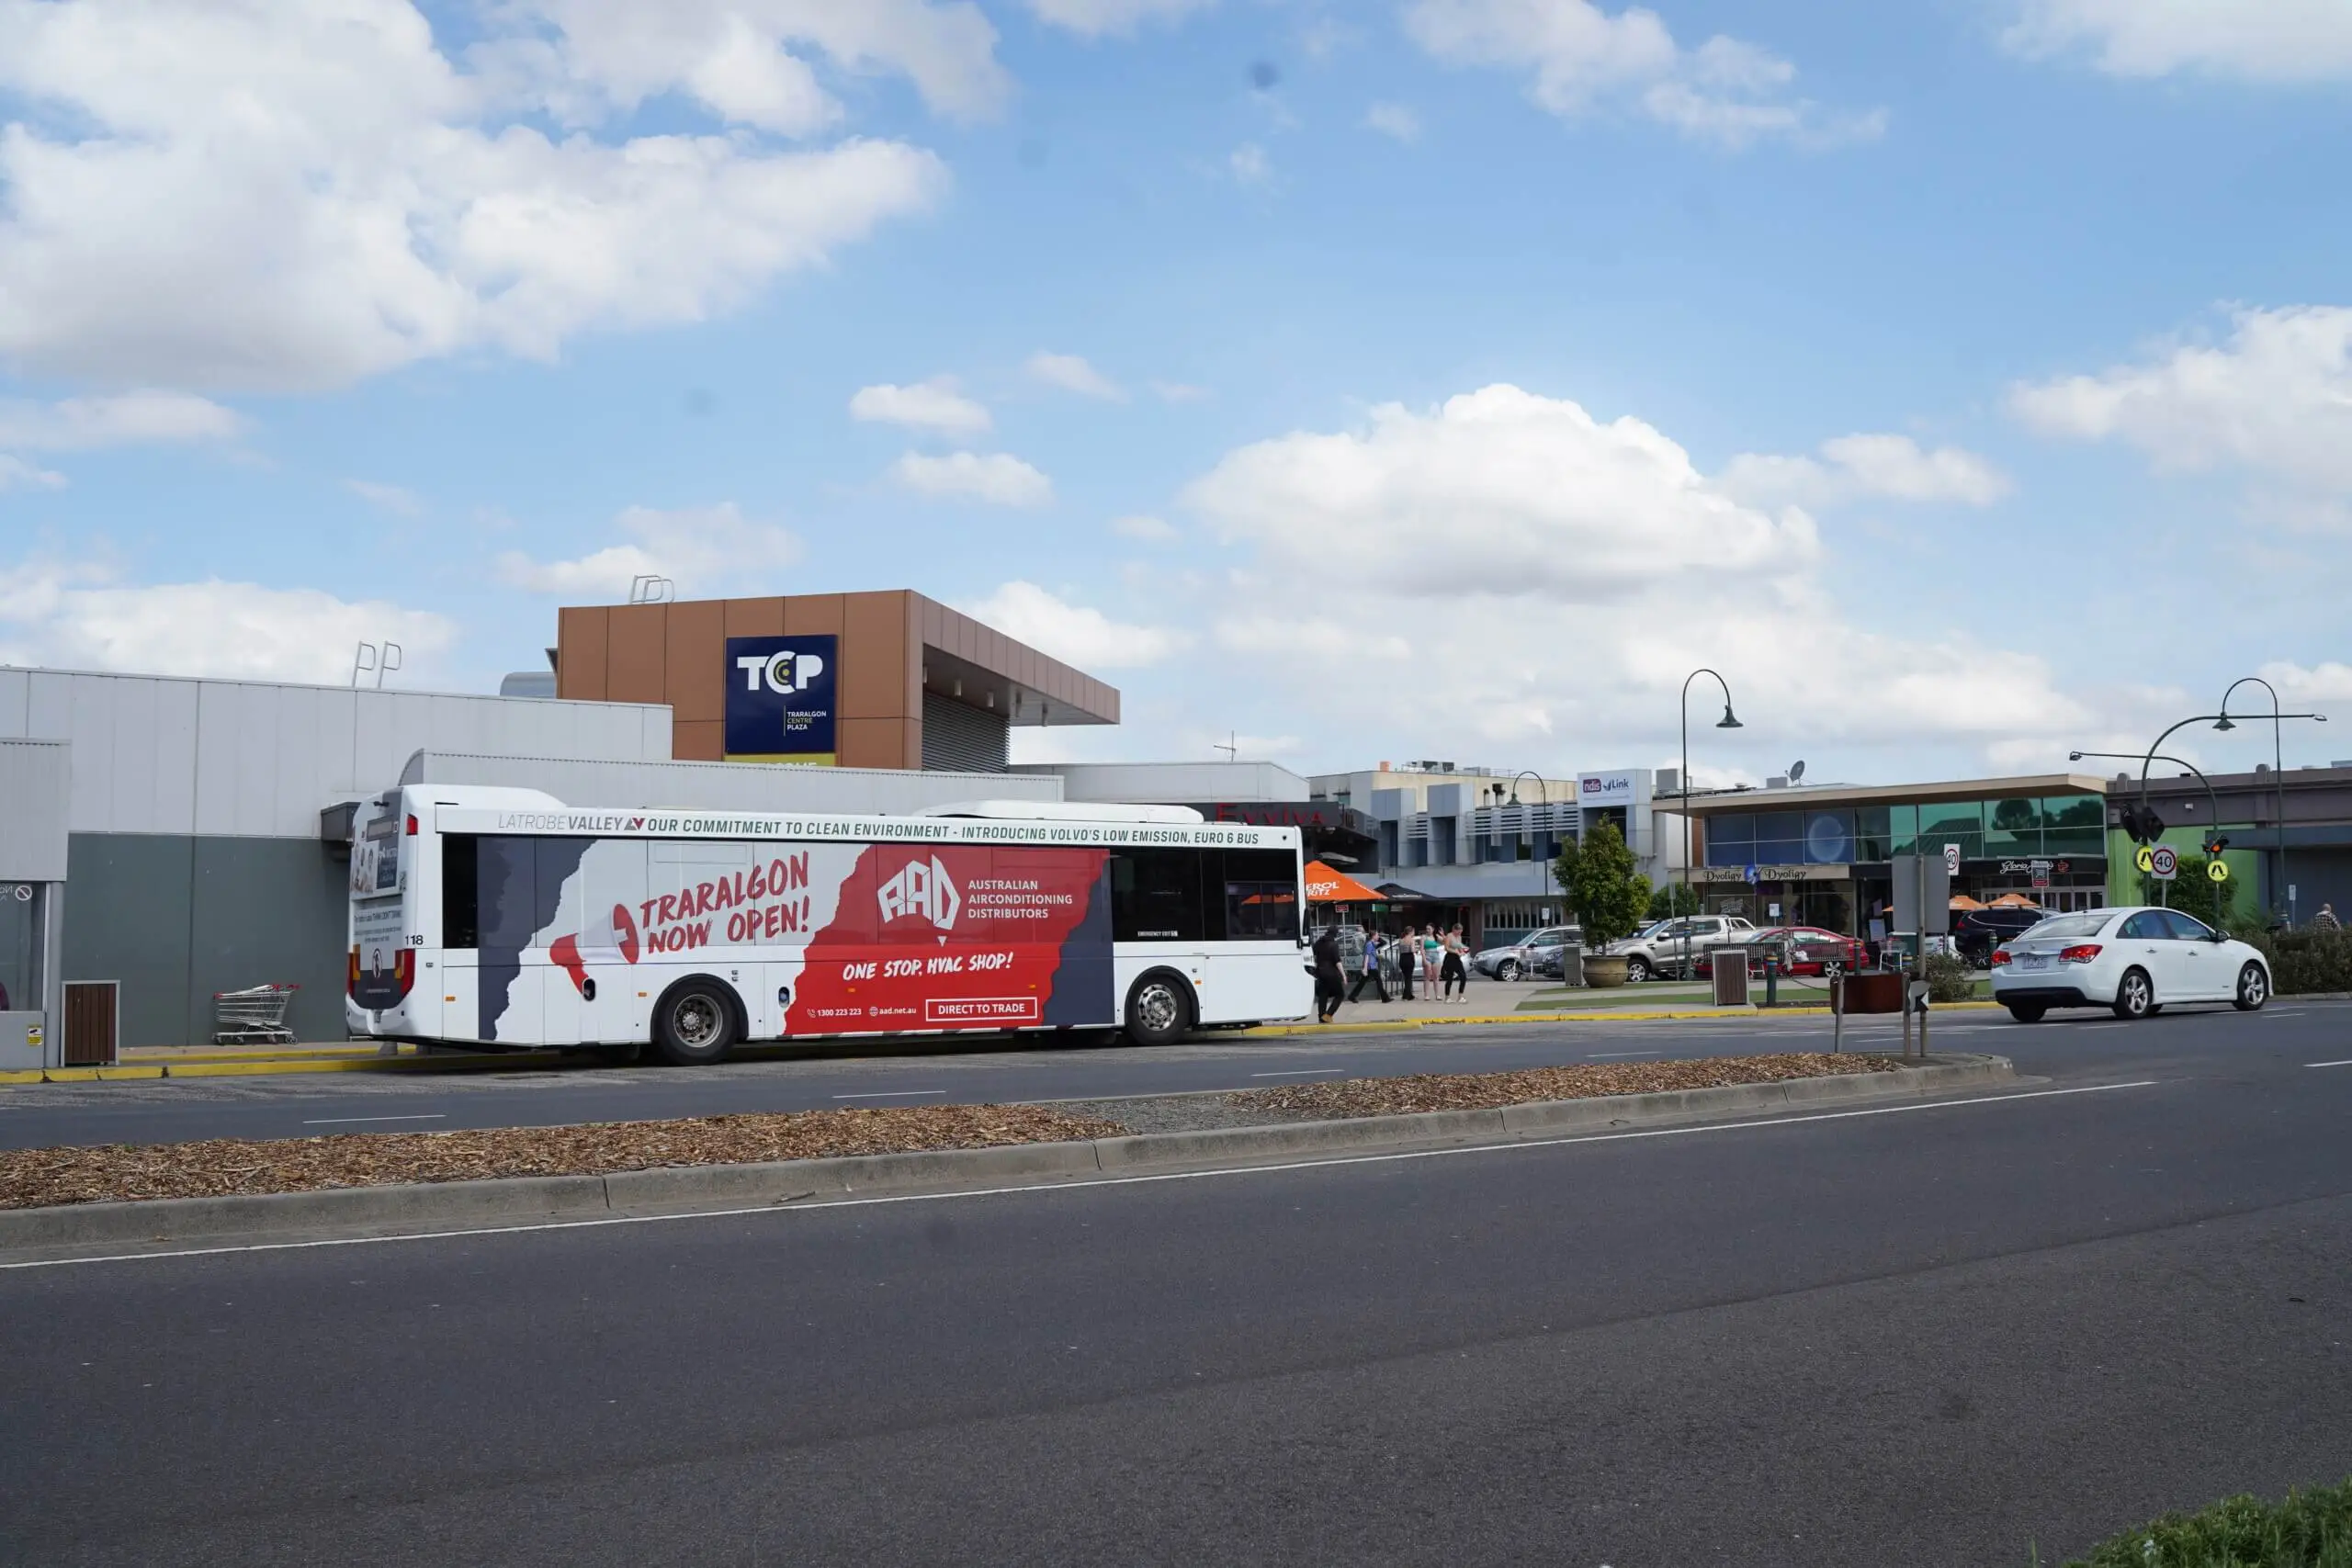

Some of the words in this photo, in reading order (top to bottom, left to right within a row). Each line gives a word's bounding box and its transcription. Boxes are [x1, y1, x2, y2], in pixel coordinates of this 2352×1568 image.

[737, 650, 823, 694] TCP
[1584, 780, 1600, 792] ndis
[1611, 778, 1629, 789] Link
[648, 818, 678, 831] OUR
[683, 818, 782, 834] COMMITMENT
[786, 821, 802, 835] TO
[807, 822, 850, 836] CLEAN
[854, 823, 950, 838] ENVIRONMENT
[962, 826, 1046, 840] INTRODUCING
[1050, 829, 1100, 841] VOLVO'S
[1103, 829, 1129, 842] LOW
[1132, 829, 1191, 844] EMISSION,
[1194, 831, 1225, 844] EURO
[1227, 832, 1234, 844] 6
[1237, 833, 1260, 845] BUS
[1947, 853, 1956, 865] 40
[2155, 856, 2172, 868] 40
[639, 851, 809, 930] TRARALGON
[967, 880, 1038, 890] AUSTRALIAN
[1306, 881, 1340, 890] EROL
[967, 894, 1073, 905] AIRCONDITIONING
[967, 908, 1048, 919] DISTRIBUTORS
[648, 918, 713, 954] NOW
[727, 895, 810, 942] OPEN!
[405, 935, 424, 946] 118
[842, 962, 878, 981] ONE
[926, 955, 964, 975] HVAC
[967, 952, 1014, 972] SHOP!
[817, 1009, 834, 1017] 1300
[850, 1008, 862, 1016] 223
[878, 1007, 917, 1015] aad.net.au
[938, 1005, 974, 1016] DIRECT
[977, 1004, 990, 1014] TO
[993, 1003, 1026, 1013] TRADE
